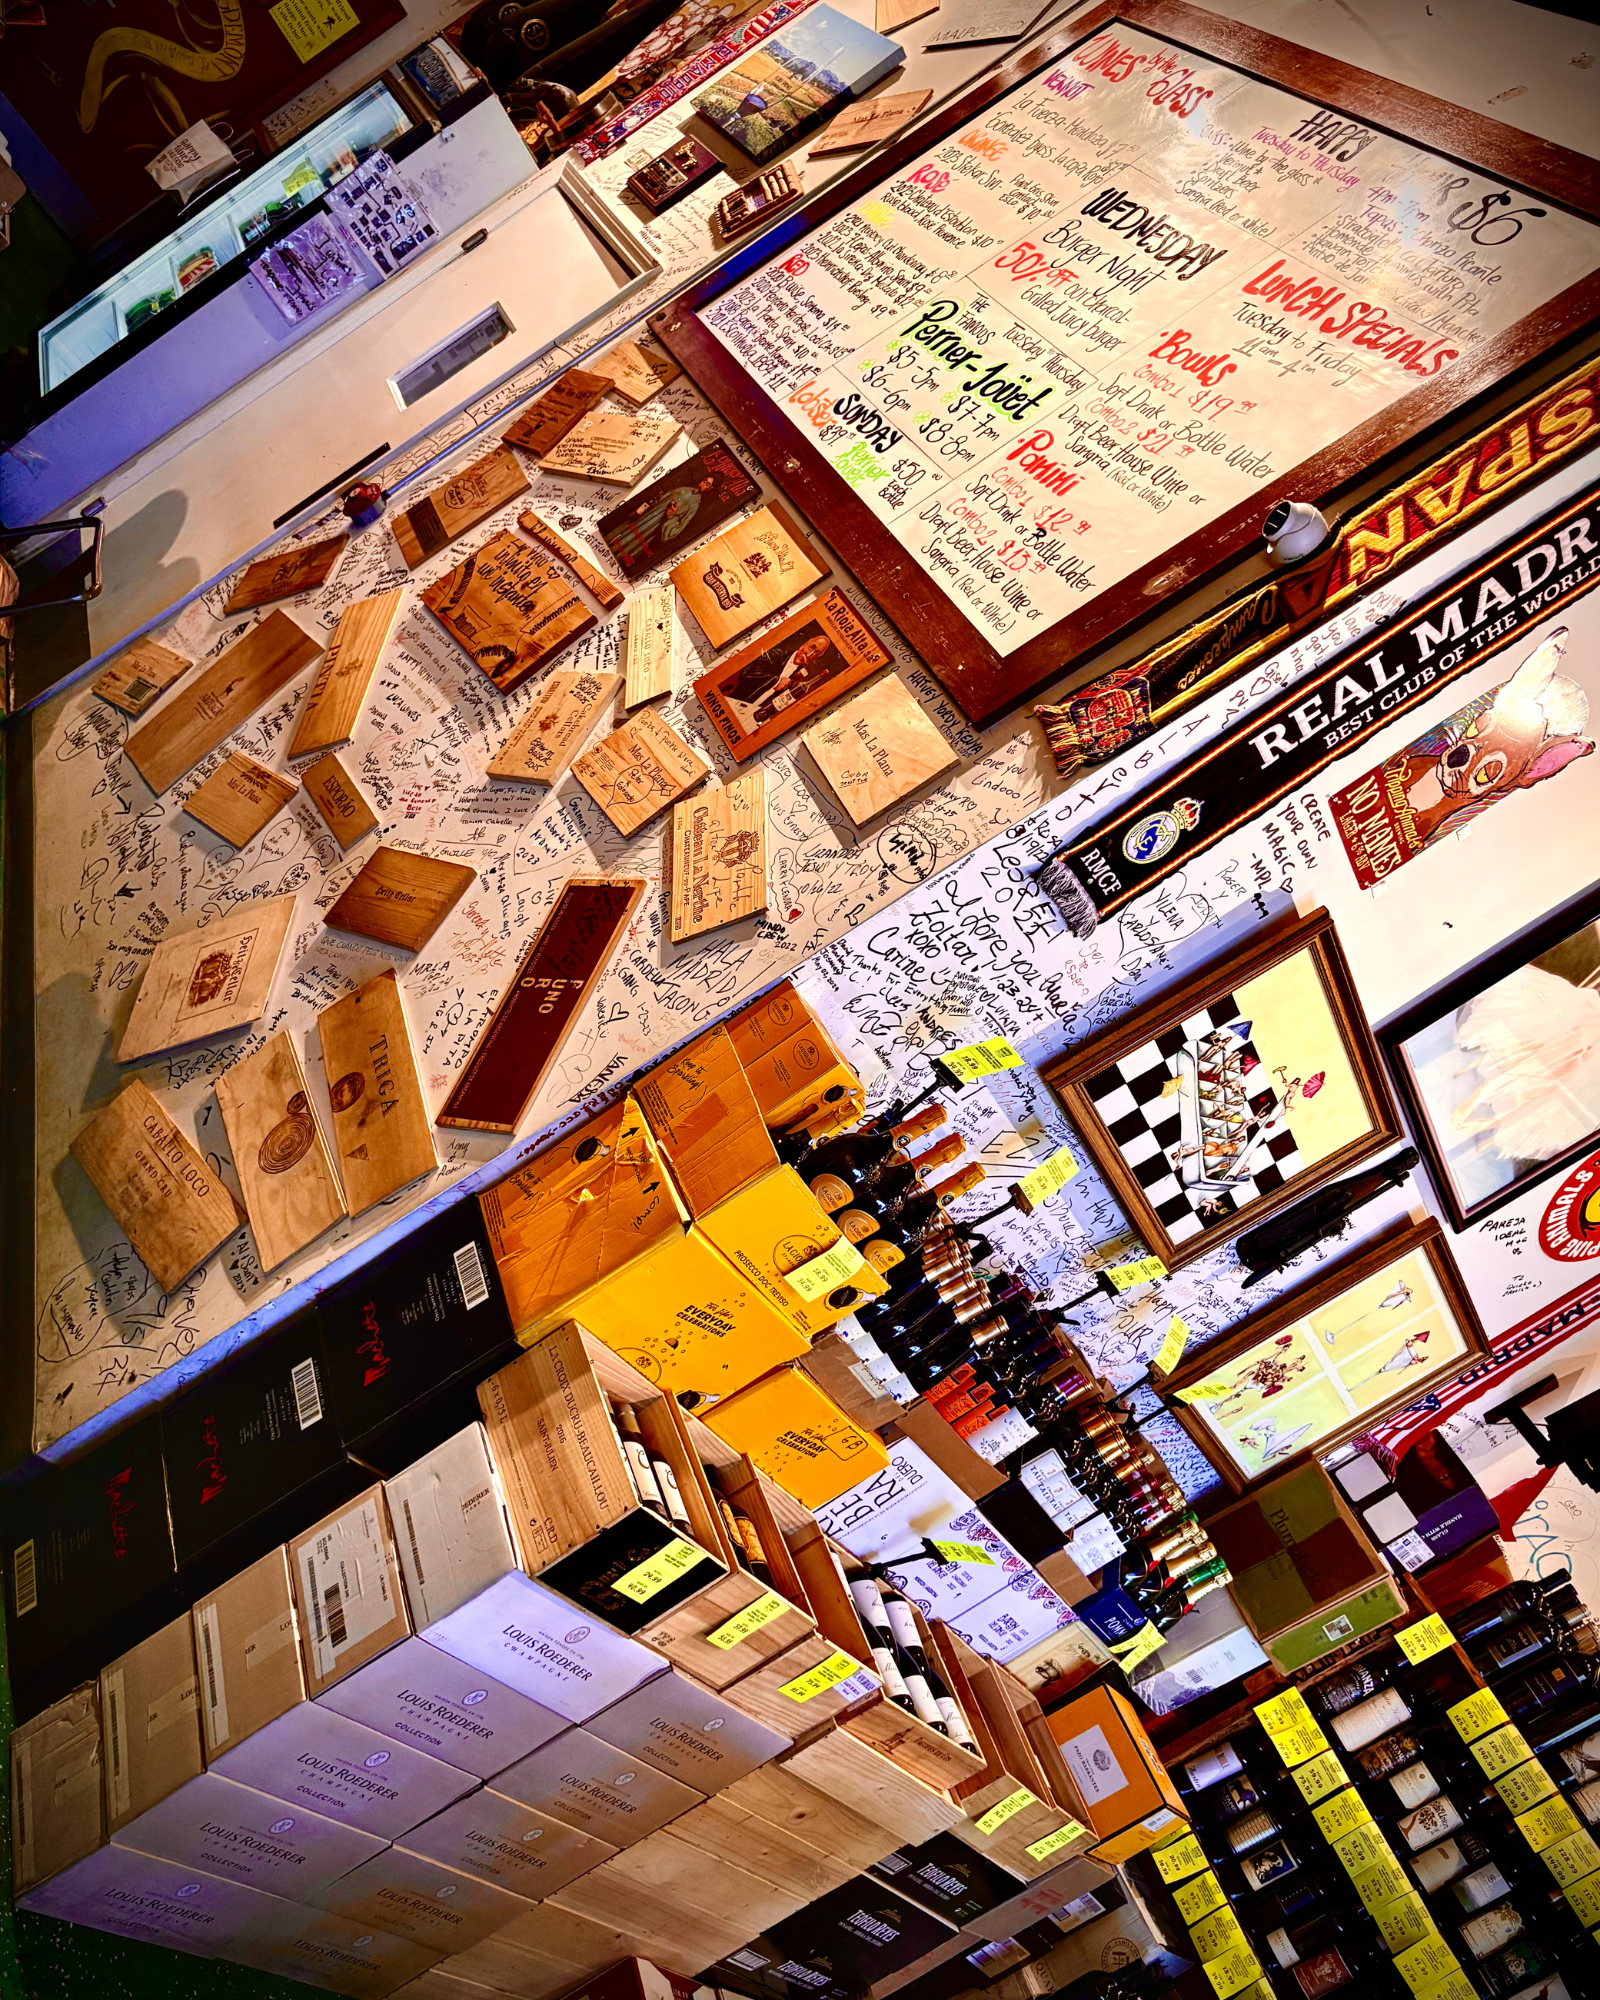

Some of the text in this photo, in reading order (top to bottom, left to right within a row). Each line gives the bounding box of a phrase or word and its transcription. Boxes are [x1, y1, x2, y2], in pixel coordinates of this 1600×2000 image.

[1072, 34, 1143, 83] WINES
[1142, 47, 1169, 73] by
[1155, 53, 1179, 75] the
[957, 129, 1008, 162] ORANGE
[1251, 125, 1298, 160] Tuesday
[1289, 109, 1547, 245] HAPPY $6
[1080, 187, 1229, 281] WEDNESDAY
[778, 251, 817, 283] RED
[994, 241, 1059, 282] 50%
[1045, 263, 1080, 288] OFF
[1026, 219, 1168, 301] Burger Night
[955, 310, 996, 346] FAMOUS
[969, 292, 1047, 363] THE Tuesday
[1020, 284, 1068, 316] Grilled
[1050, 305, 1090, 338] Juicy
[1241, 259, 1460, 377] LUNCH SPECIALS
[1232, 301, 1293, 346] Tuesday
[1293, 340, 1363, 387] Friday
[789, 380, 838, 433] Lobster
[832, 393, 904, 454] SUNDAY
[1125, 388, 1166, 420] Drink
[1158, 420, 1177, 431] or
[1172, 419, 1227, 456] Bottle
[1224, 444, 1276, 479] Water
[1005, 429, 1088, 497] Panini
[920, 537, 960, 579] Sangria
[988, 492, 1023, 525] Drink
[1022, 520, 1066, 567] Bottle
[1055, 555, 1096, 593] Water
[833, 605, 861, 634] Rioja
[1238, 517, 1600, 770] REAL MADR
[1314, 707, 1377, 750] BEST
[1366, 666, 1442, 711] CLUB
[1438, 643, 1466, 671] OF
[1470, 610, 1518, 649] THE
[696, 689, 734, 723] VINOS
[852, 718, 869, 741] Mas
[864, 734, 894, 778] La Plana
[972, 745, 1026, 780] Love you
[322, 774, 358, 818] ESPORÃO
[1300, 793, 1331, 842] CREATE
[1276, 801, 1318, 870] YOUR OWN
[1339, 809, 1363, 837] LAGER
[1354, 851, 1375, 873] ABV
[1346, 775, 1417, 878] NO MAMES
[1070, 847, 1122, 896] RMCF
[754, 912, 789, 941] MINDO
[958, 899, 1022, 955] Love
[356, 1033, 425, 1119] TRIGA
[134, 1150, 173, 1202] GRAND CRU
[143, 1115, 210, 1198] CABALLO LOCO
[727, 1249, 789, 1307] PROSECCO DOC TREVISO
[676, 1308, 727, 1338] CELEBRATIONS
[683, 1304, 737, 1335] EVERYDAY
[536, 1417, 566, 1472] SAINT-JULIEN
[548, 1345, 609, 1510] LA CROIX DUCRU-BEAUCAILLOU
[552, 1423, 567, 1444] 2016
[776, 1433, 819, 1459] CELEBRATIONS
[783, 1430, 828, 1456] EVERYDAY
[891, 1455, 924, 1486] DUERO
[502, 1624, 593, 1682] LOUIS ROEDERER
[394, 1722, 443, 1746] COLLECTION
[396, 1689, 494, 1740] LOUIS ROEDERER
[559, 1773, 637, 1814] LOUIS ROEDERER
